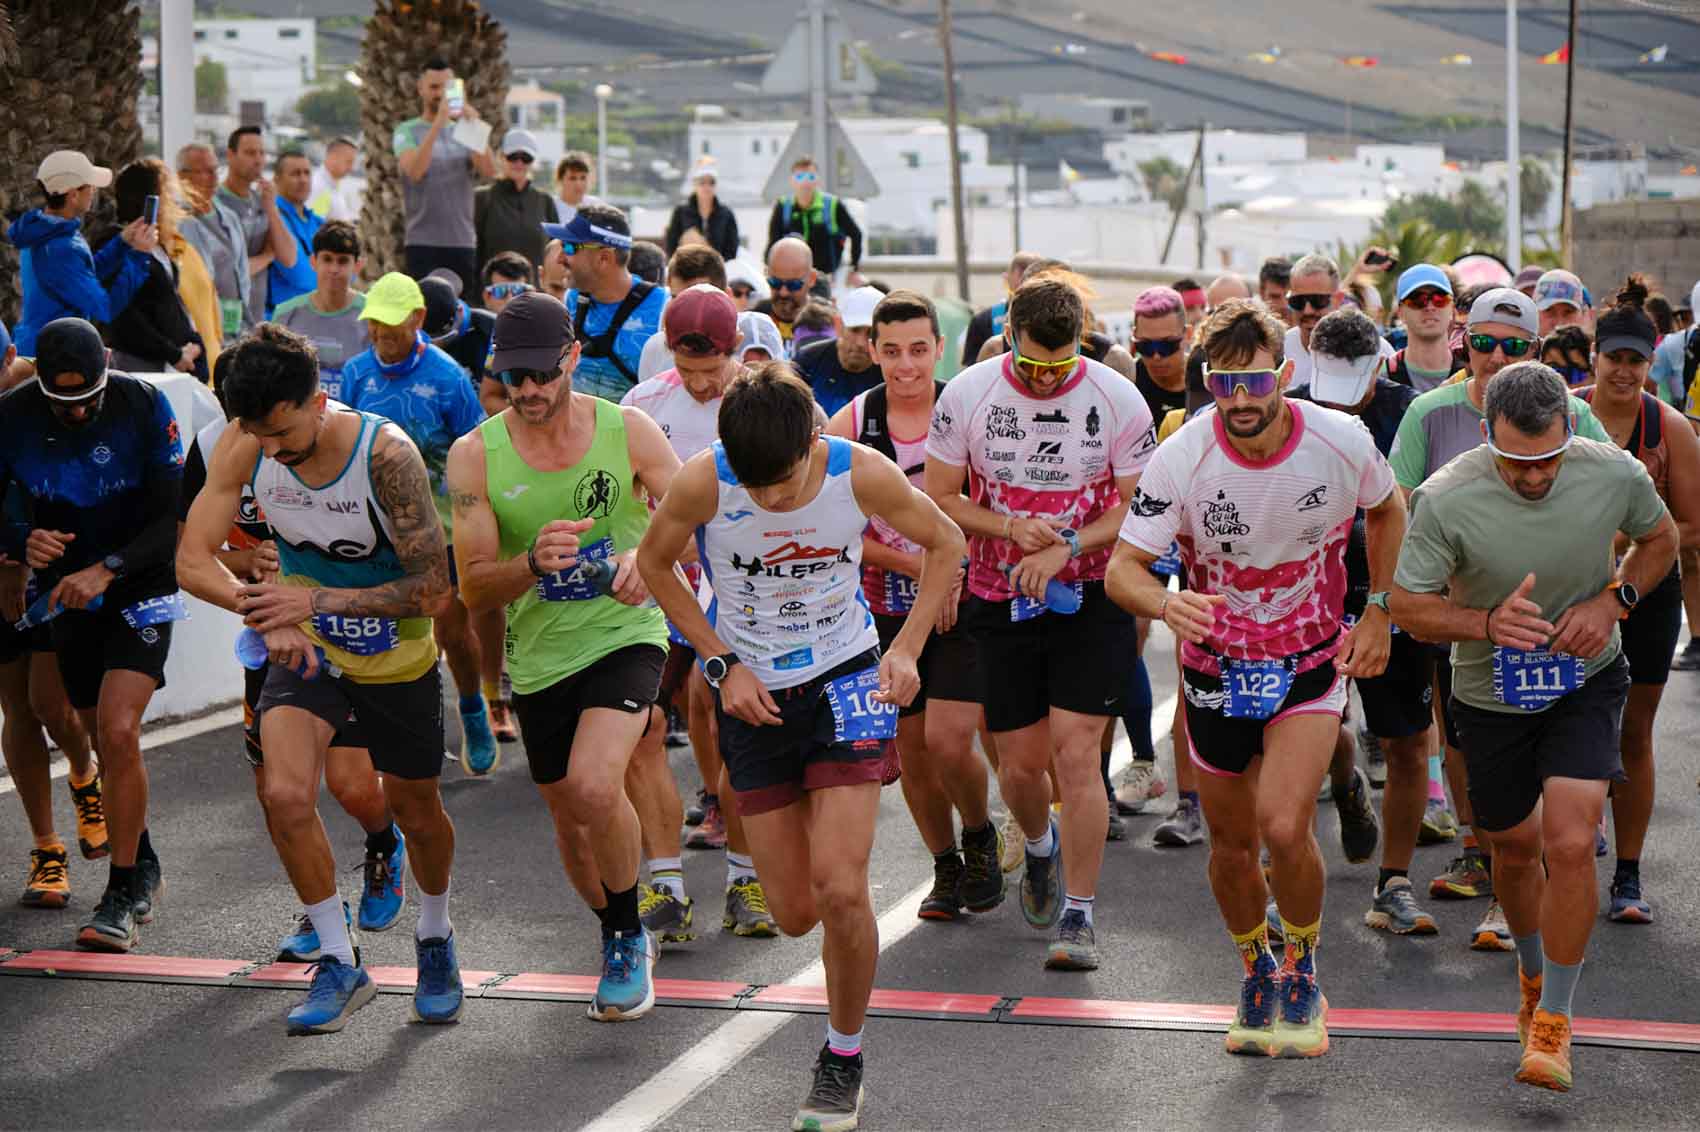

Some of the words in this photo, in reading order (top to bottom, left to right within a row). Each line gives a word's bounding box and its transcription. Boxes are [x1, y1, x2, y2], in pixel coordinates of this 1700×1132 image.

[551, 568, 586, 587] 14
[326, 615, 382, 639] 158
[1236, 673, 1281, 698] 122
[1515, 666, 1566, 691] 111
